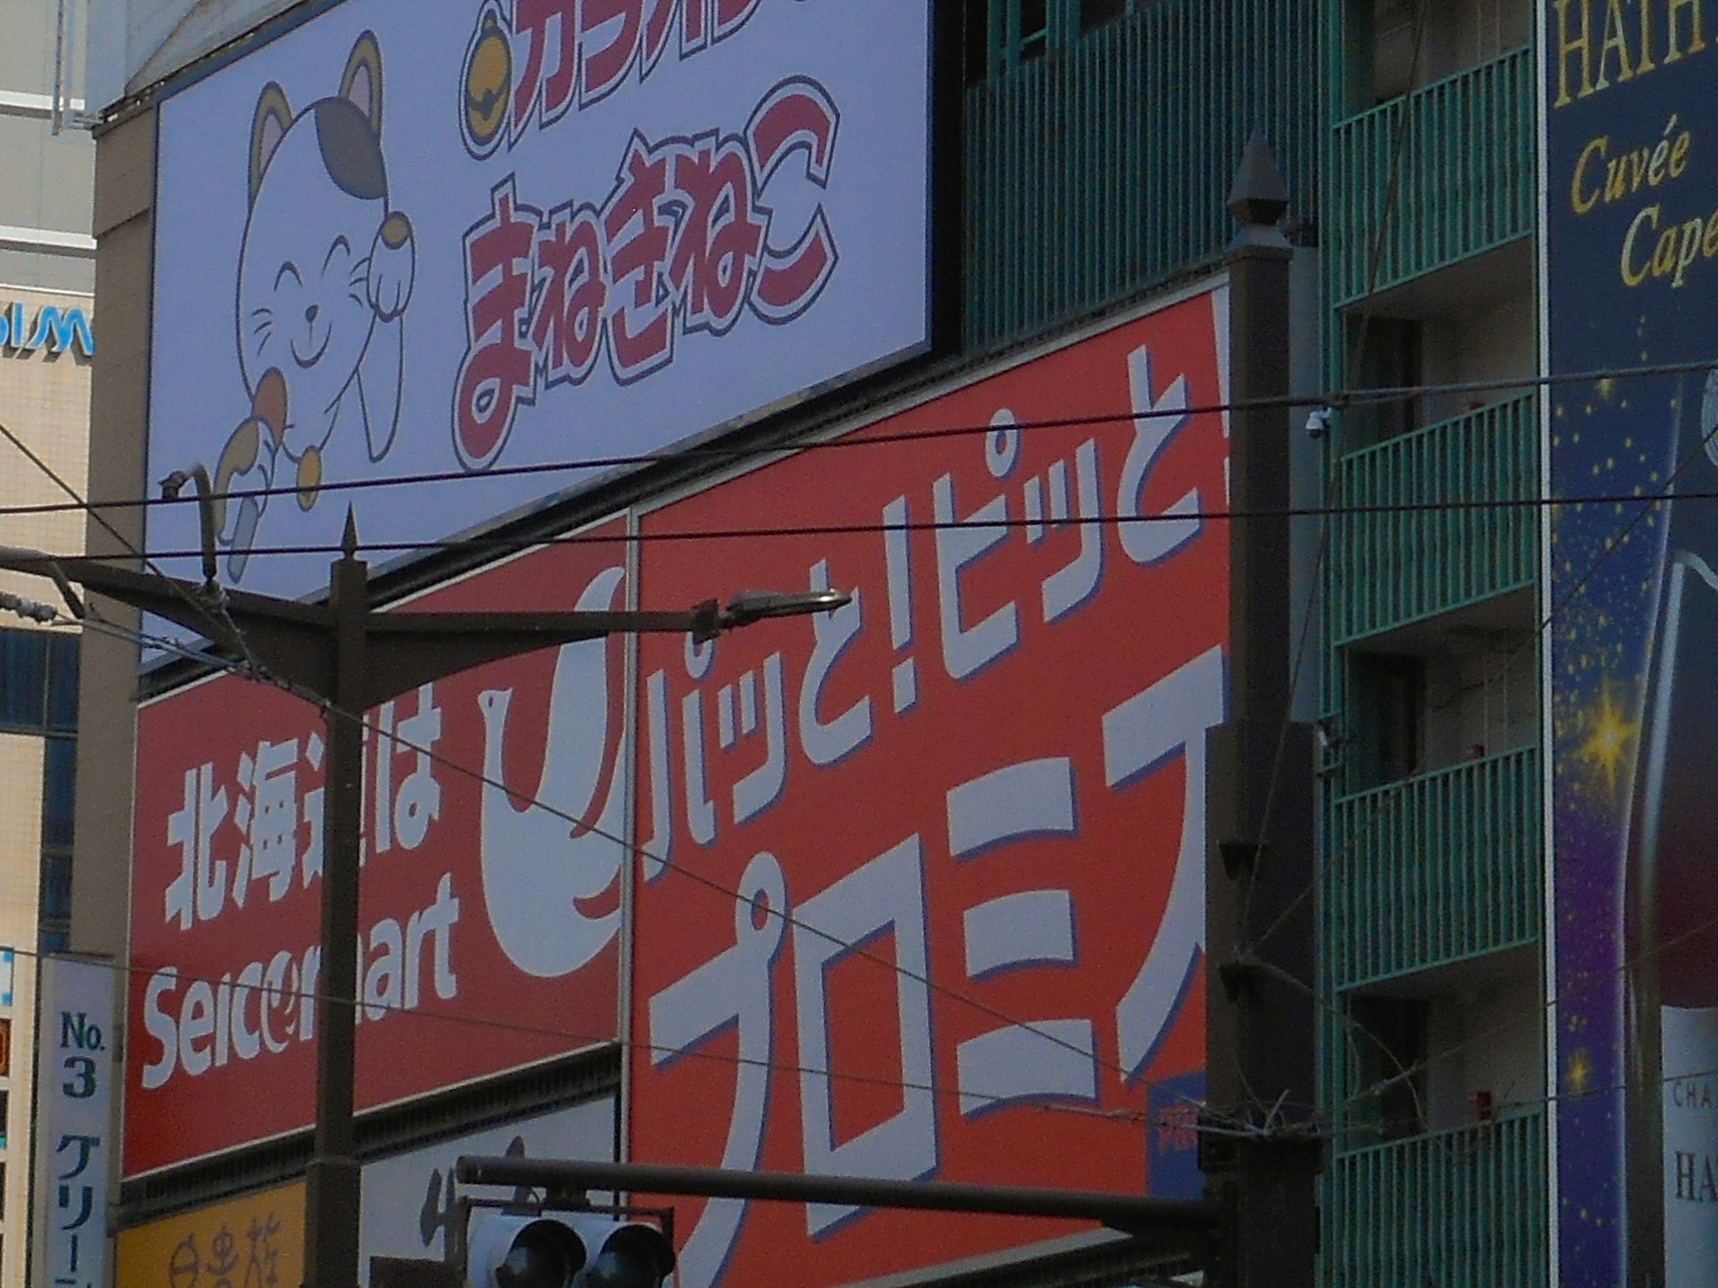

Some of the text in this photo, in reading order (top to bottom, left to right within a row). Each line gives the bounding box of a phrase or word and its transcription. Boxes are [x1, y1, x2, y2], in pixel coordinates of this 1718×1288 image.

[455, 79, 839, 469] まねきねこ
[1571, 114, 1691, 214] Cuvée
